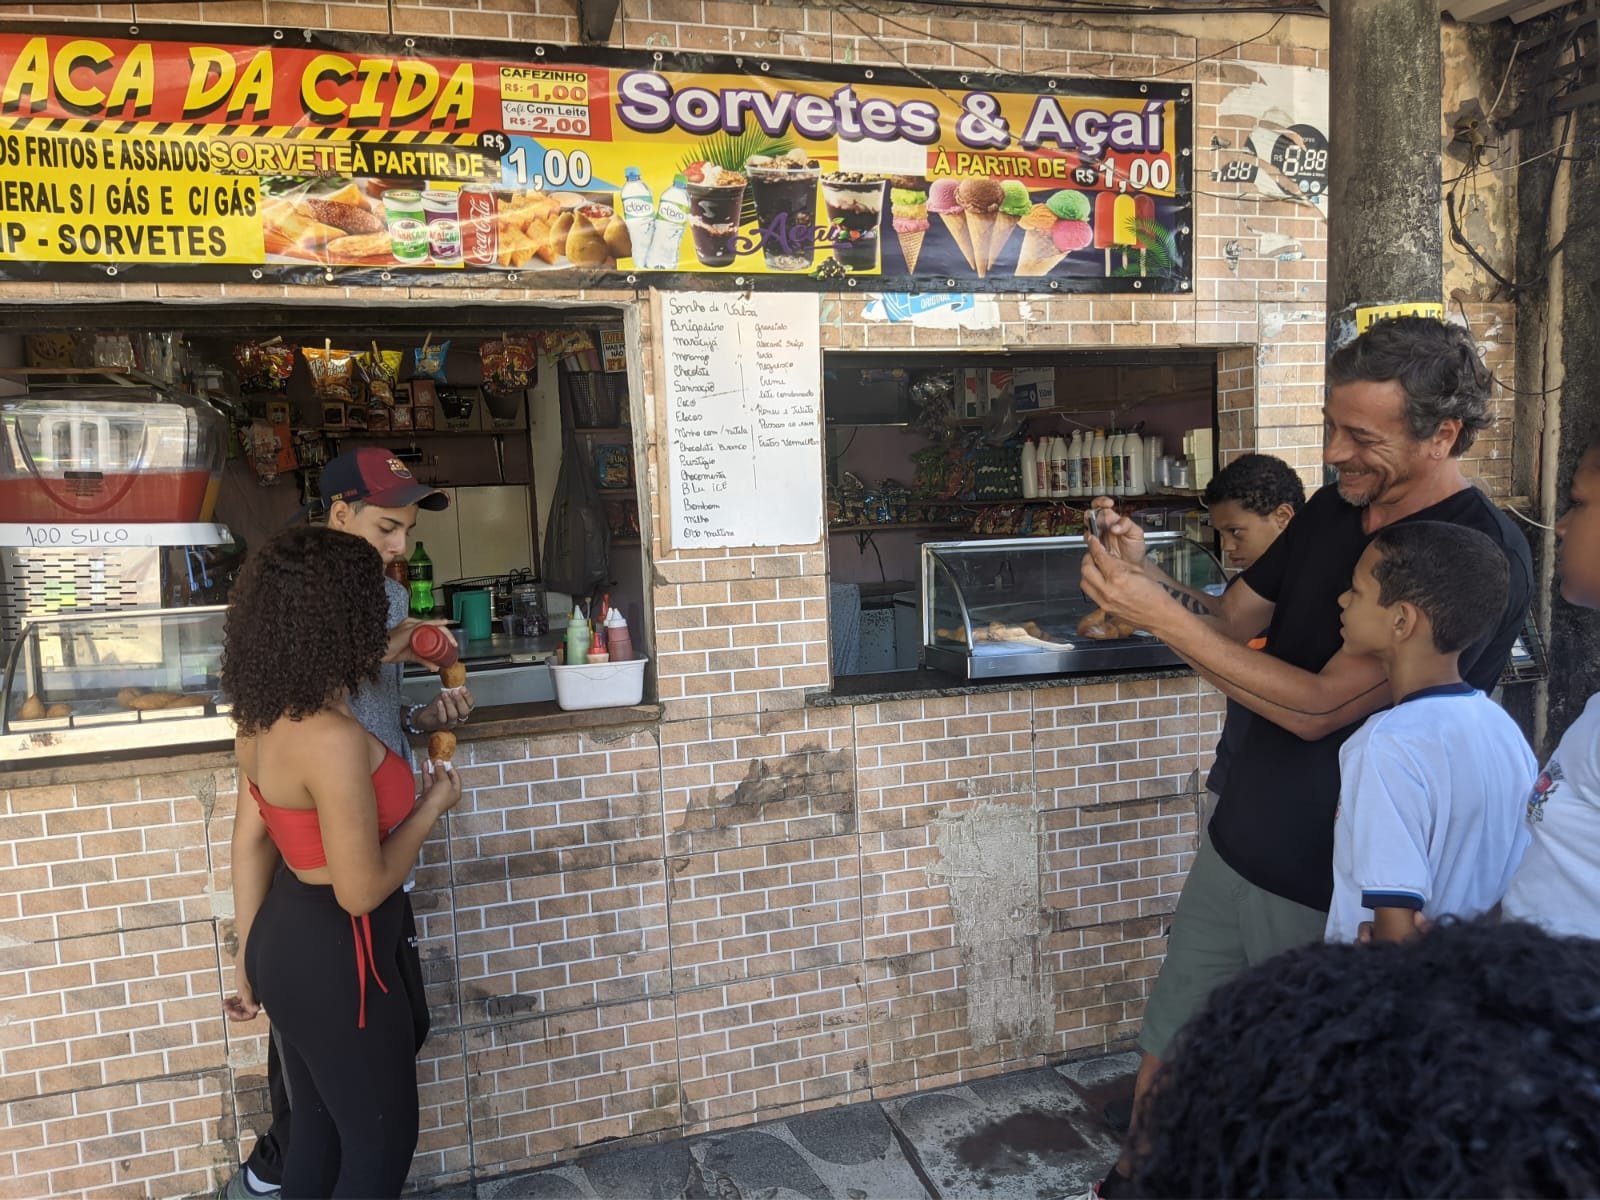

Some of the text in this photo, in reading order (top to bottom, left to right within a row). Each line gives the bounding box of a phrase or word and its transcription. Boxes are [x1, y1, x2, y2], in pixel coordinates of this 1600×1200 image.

[2, 37, 475, 129] ACA DA CIDA
[501, 68, 586, 82] CAFEZINHO
[527, 83, 587, 102] 1,00
[527, 104, 554, 115] Com
[558, 106, 587, 117] Leite
[533, 116, 587, 133] 2,00
[617, 71, 1164, 156] Sorvetes & Açaí
[25, 136, 98, 169] FRITOS
[102, 139, 116, 170] E
[120, 140, 210, 172] ASSADOS
[211, 141, 353, 173] SORVETE
[373, 153, 450, 175] PARTIR
[456, 155, 484, 178] DE
[482, 135, 592, 191] R$ 1,00
[957, 153, 1034, 178] PARTIR
[1038, 157, 1067, 178] DE
[1075, 157, 1171, 192] R$ 1,00
[0, 180, 65, 213] ERAL
[106, 178, 150, 215] GÁS
[160, 186, 174, 216] E
[215, 180, 257, 217] GÁS
[0, 222, 26, 253] P
[58, 224, 227, 256] SORVETES
[71, 528, 129, 544] SUCO
